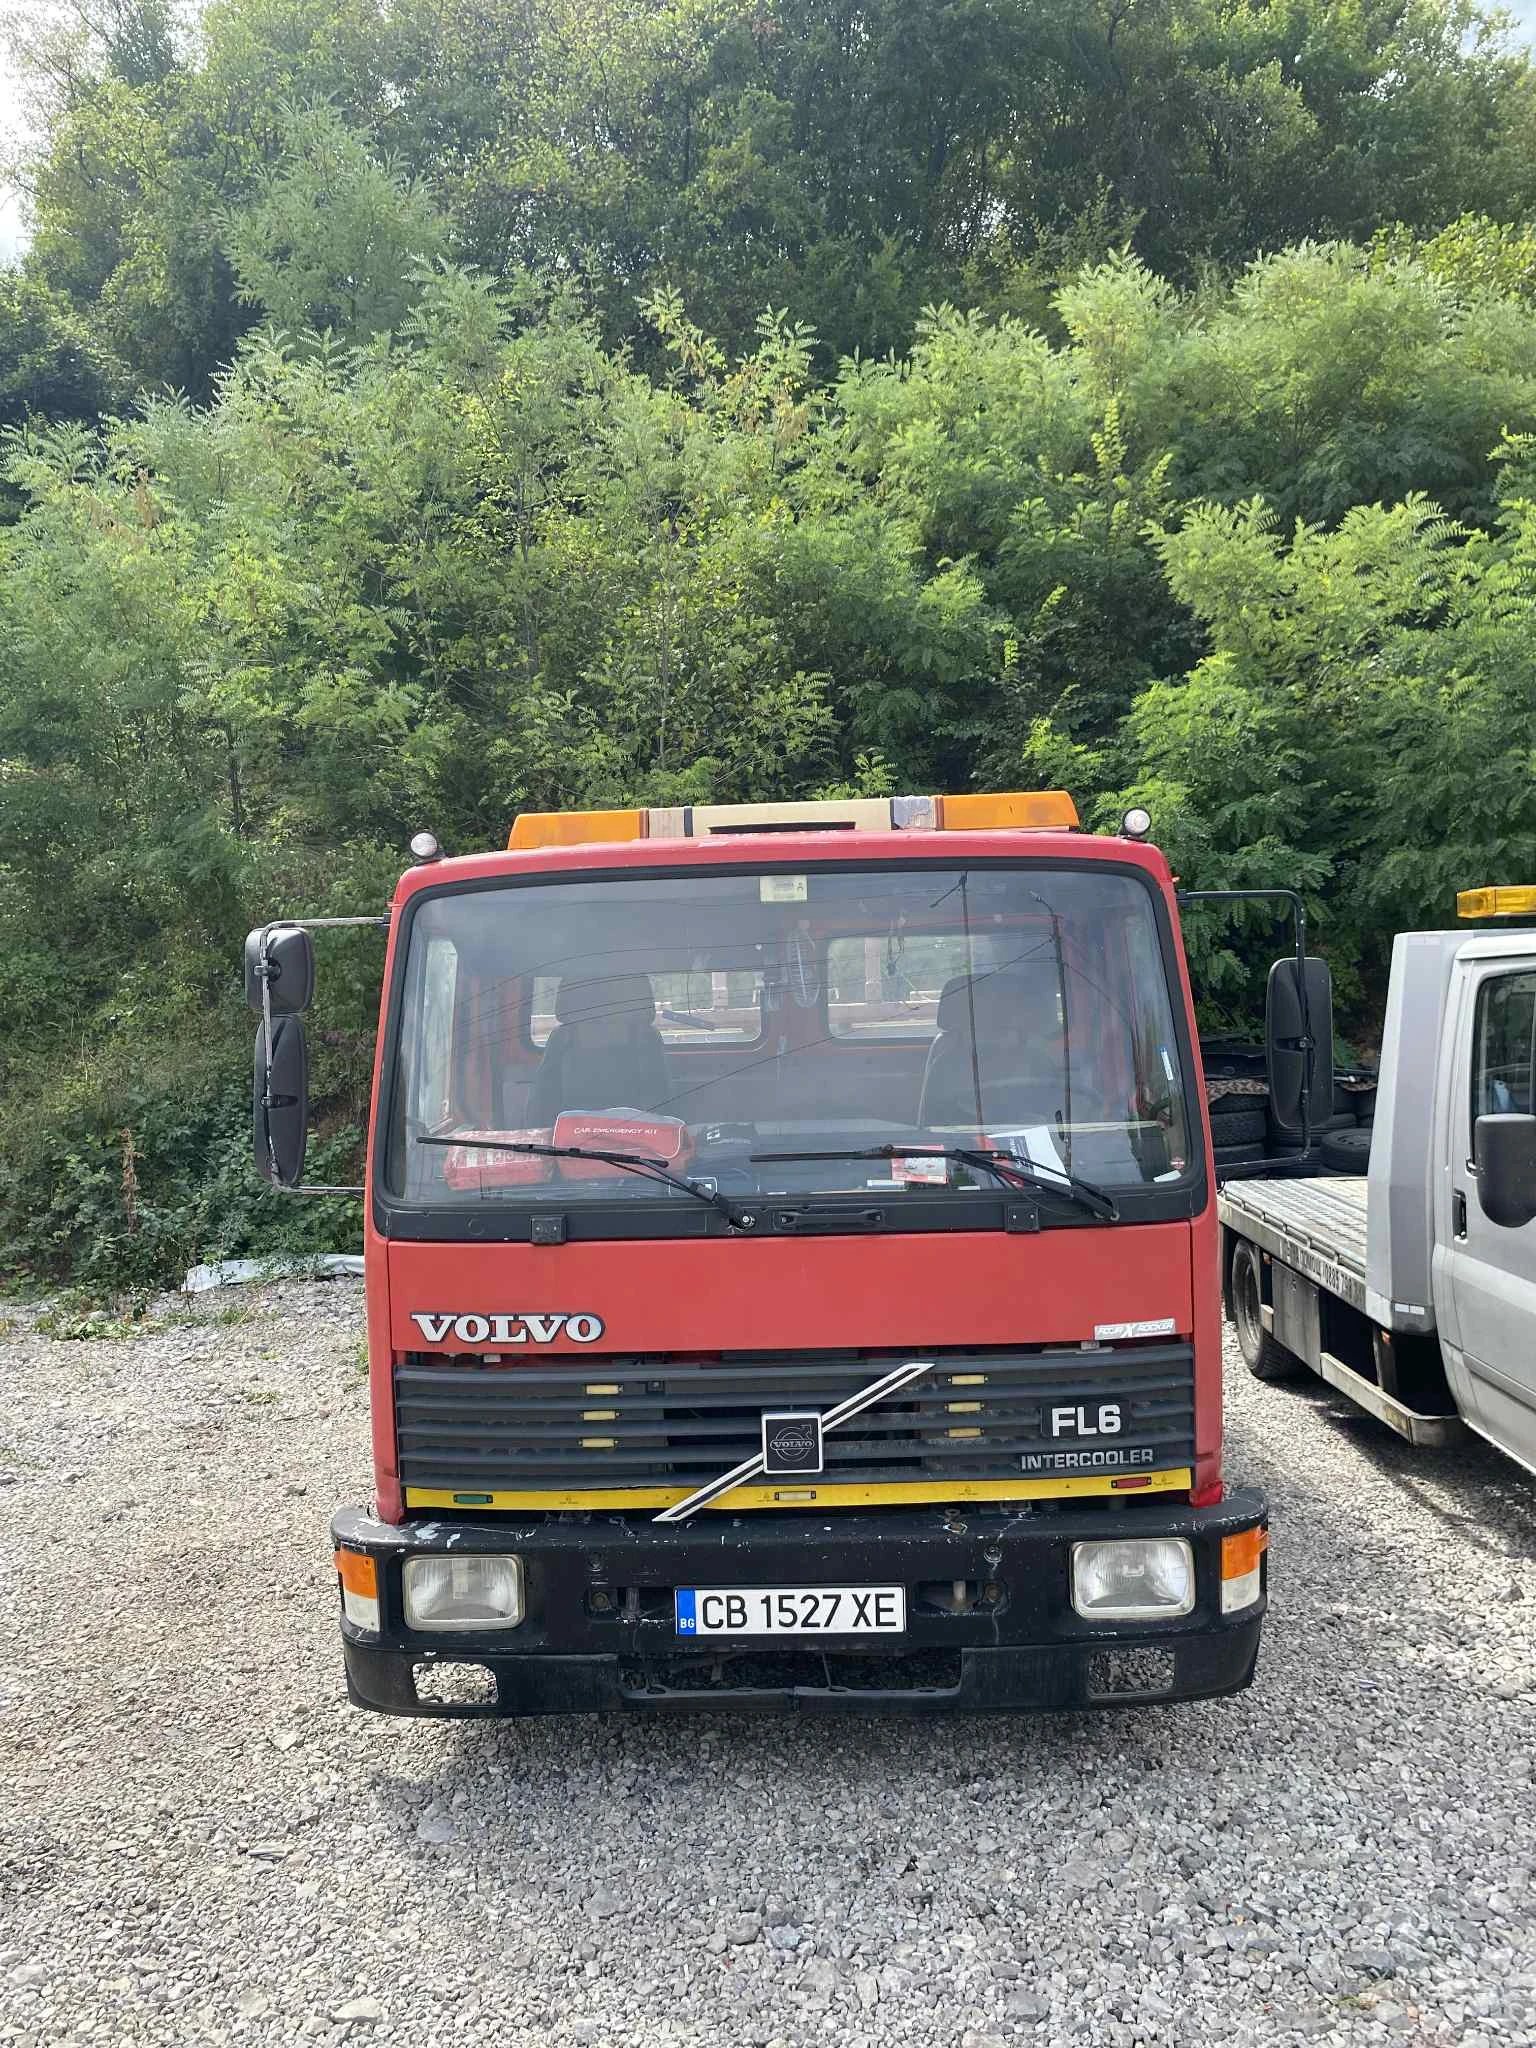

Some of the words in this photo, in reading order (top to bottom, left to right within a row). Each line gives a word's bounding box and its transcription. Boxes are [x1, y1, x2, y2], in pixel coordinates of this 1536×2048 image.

[573, 1127, 591, 1135] CAR
[411, 1313, 603, 1343] VOLVO
[1051, 1404, 1121, 1437] FL6
[772, 1440, 813, 1448] VOLVO
[1021, 1448, 1153, 1470] INTERCOOLER
[680, 1618, 695, 1629] BG
[702, 1595, 748, 1629] CB
[761, 1594, 841, 1628] 1527
[852, 1593, 897, 1627] XE
